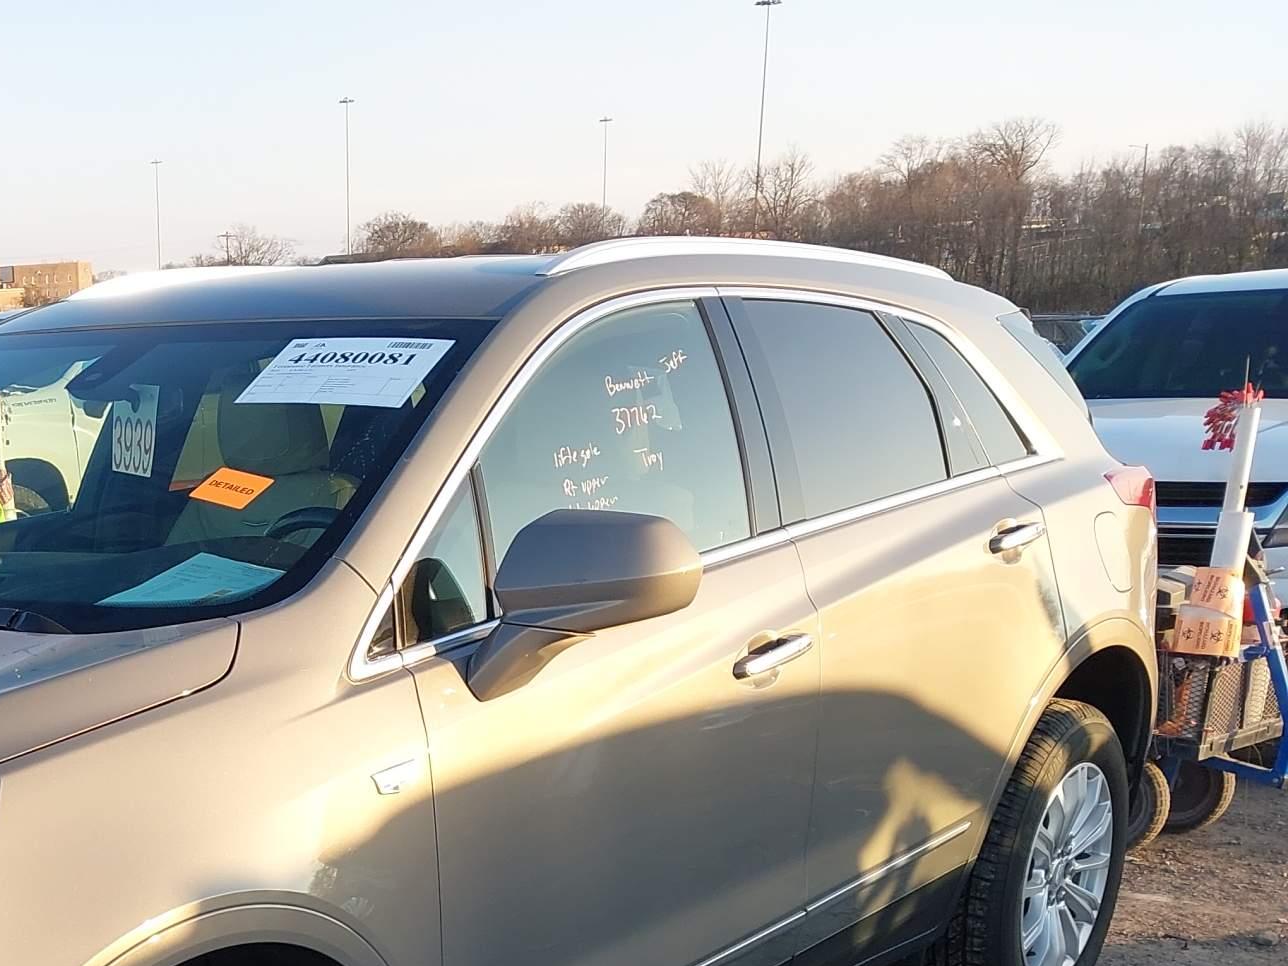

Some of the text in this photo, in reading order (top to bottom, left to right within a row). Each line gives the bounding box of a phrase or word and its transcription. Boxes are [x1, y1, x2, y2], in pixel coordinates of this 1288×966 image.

[288, 351, 417, 366] 44080081
[605, 371, 655, 397] Bennett
[611, 403, 663, 435] 37762
[113, 415, 153, 474] 3939
[633, 447, 664, 472] Troy
[208, 479, 255, 496] DETAILED
